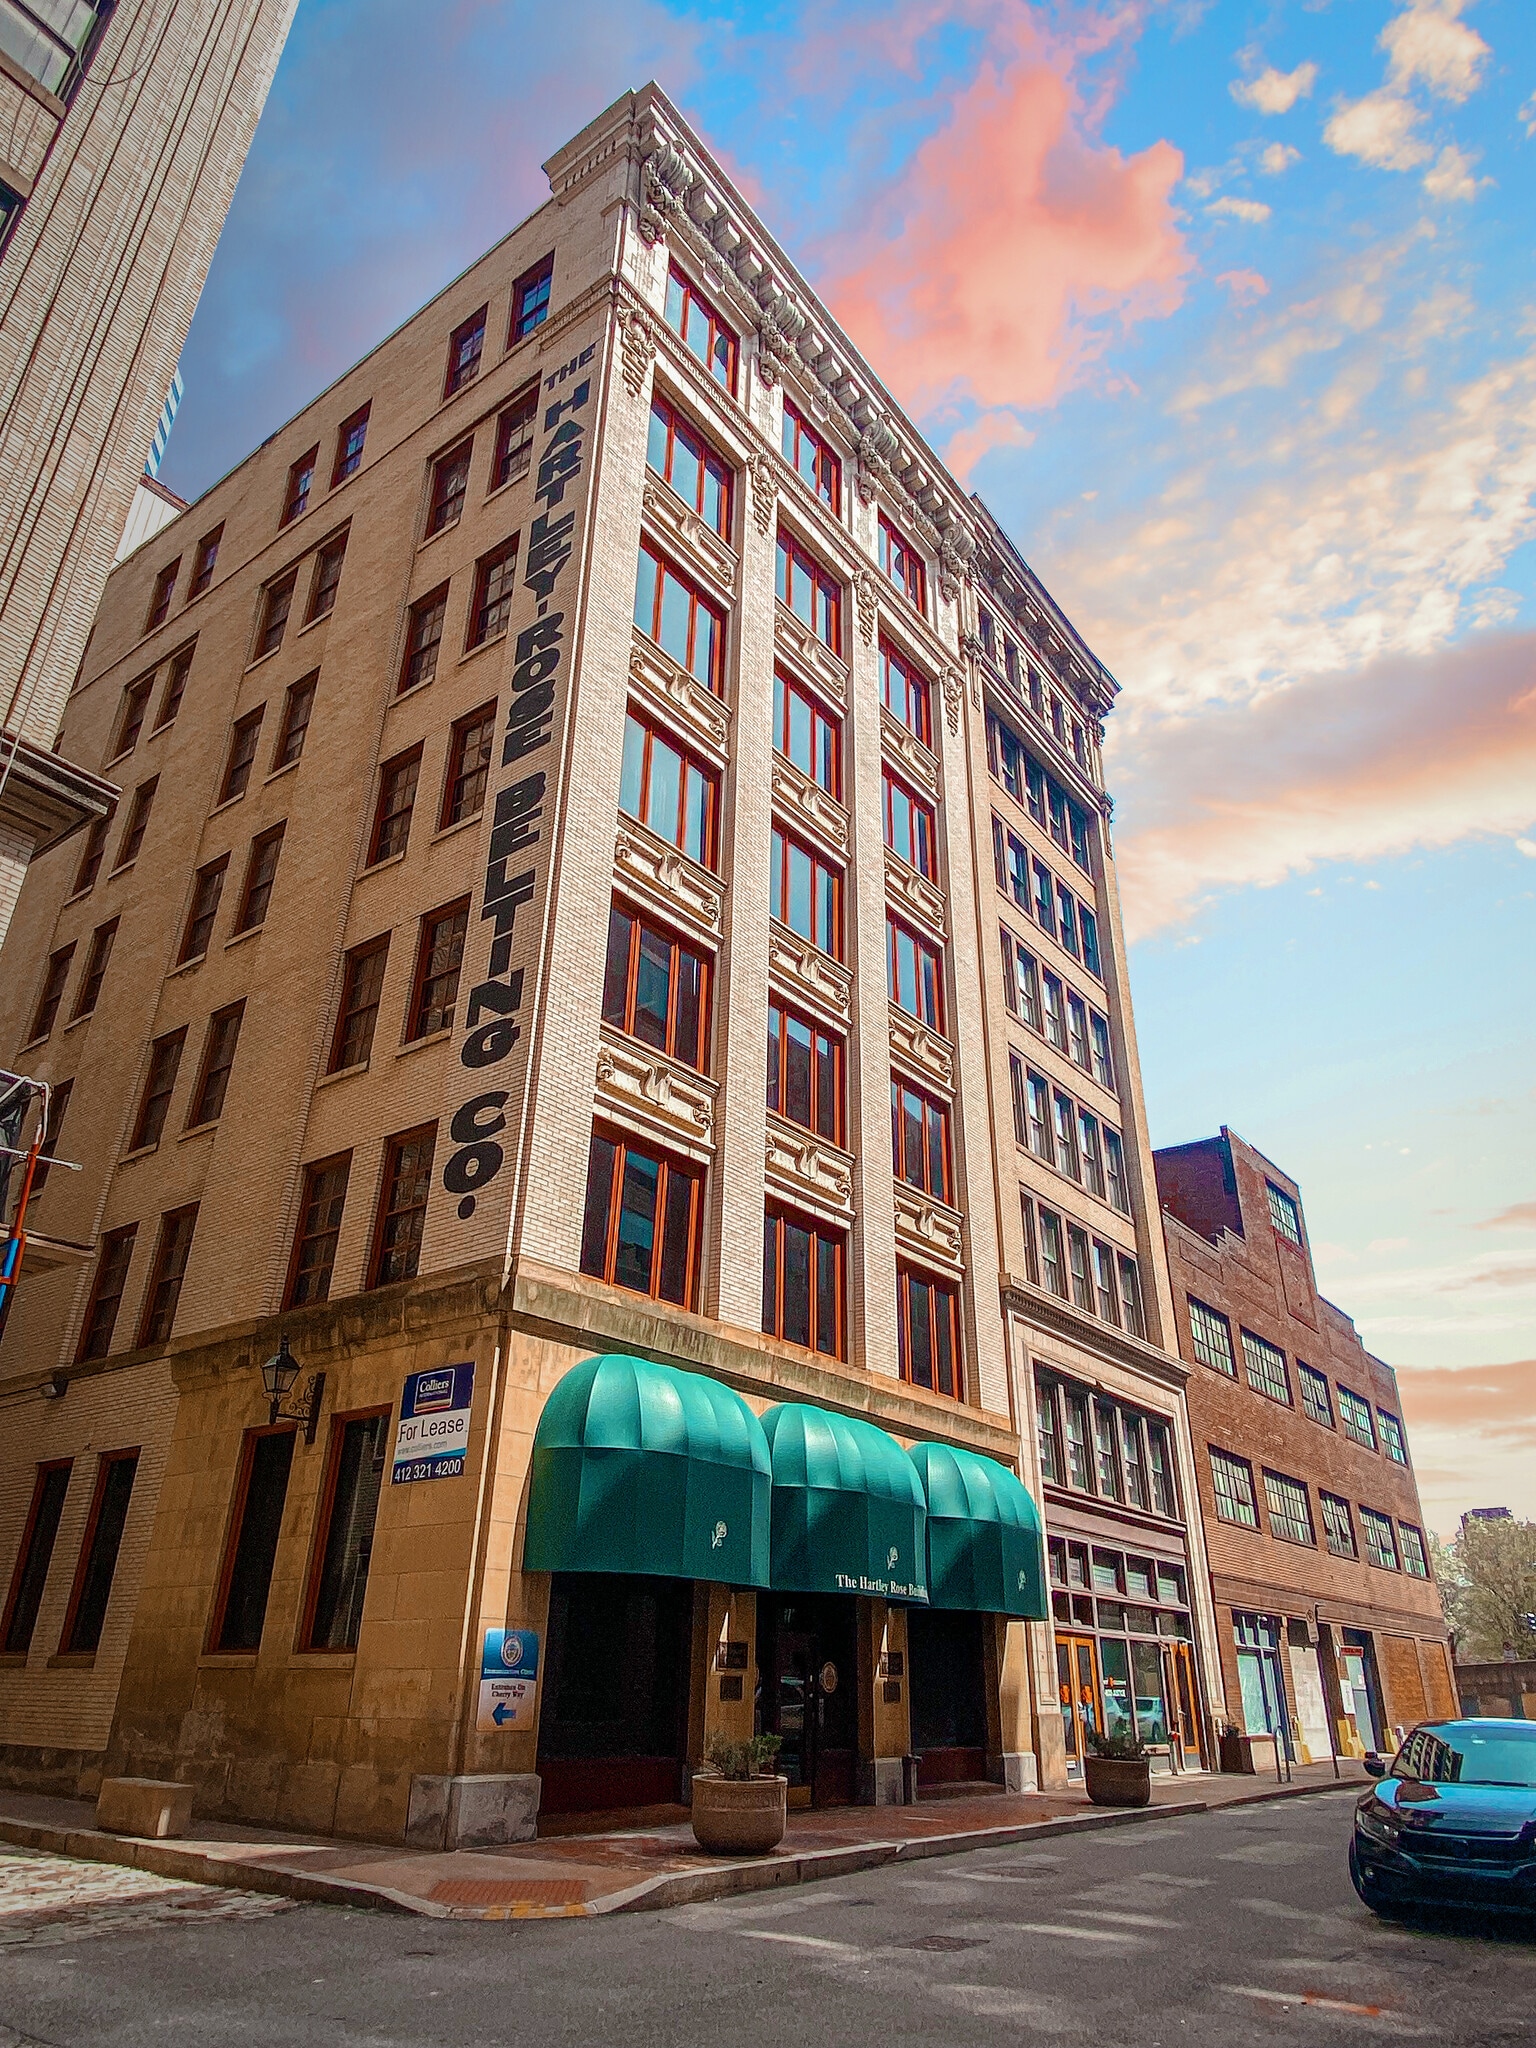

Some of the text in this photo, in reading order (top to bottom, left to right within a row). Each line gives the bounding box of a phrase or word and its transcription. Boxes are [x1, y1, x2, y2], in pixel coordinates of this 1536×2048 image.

[543, 343, 596, 391] THE
[460, 771, 546, 1069] BELTING
[420, 1379, 450, 1392] Colliers
[397, 1418, 464, 1443] For Lease
[394, 1459, 461, 1482] 412 321 4200
[835, 1574, 857, 1589] The
[860, 1576, 889, 1596] Hartley
[890, 1581, 907, 1595] Rose
[491, 1690, 511, 1699] Cherry
